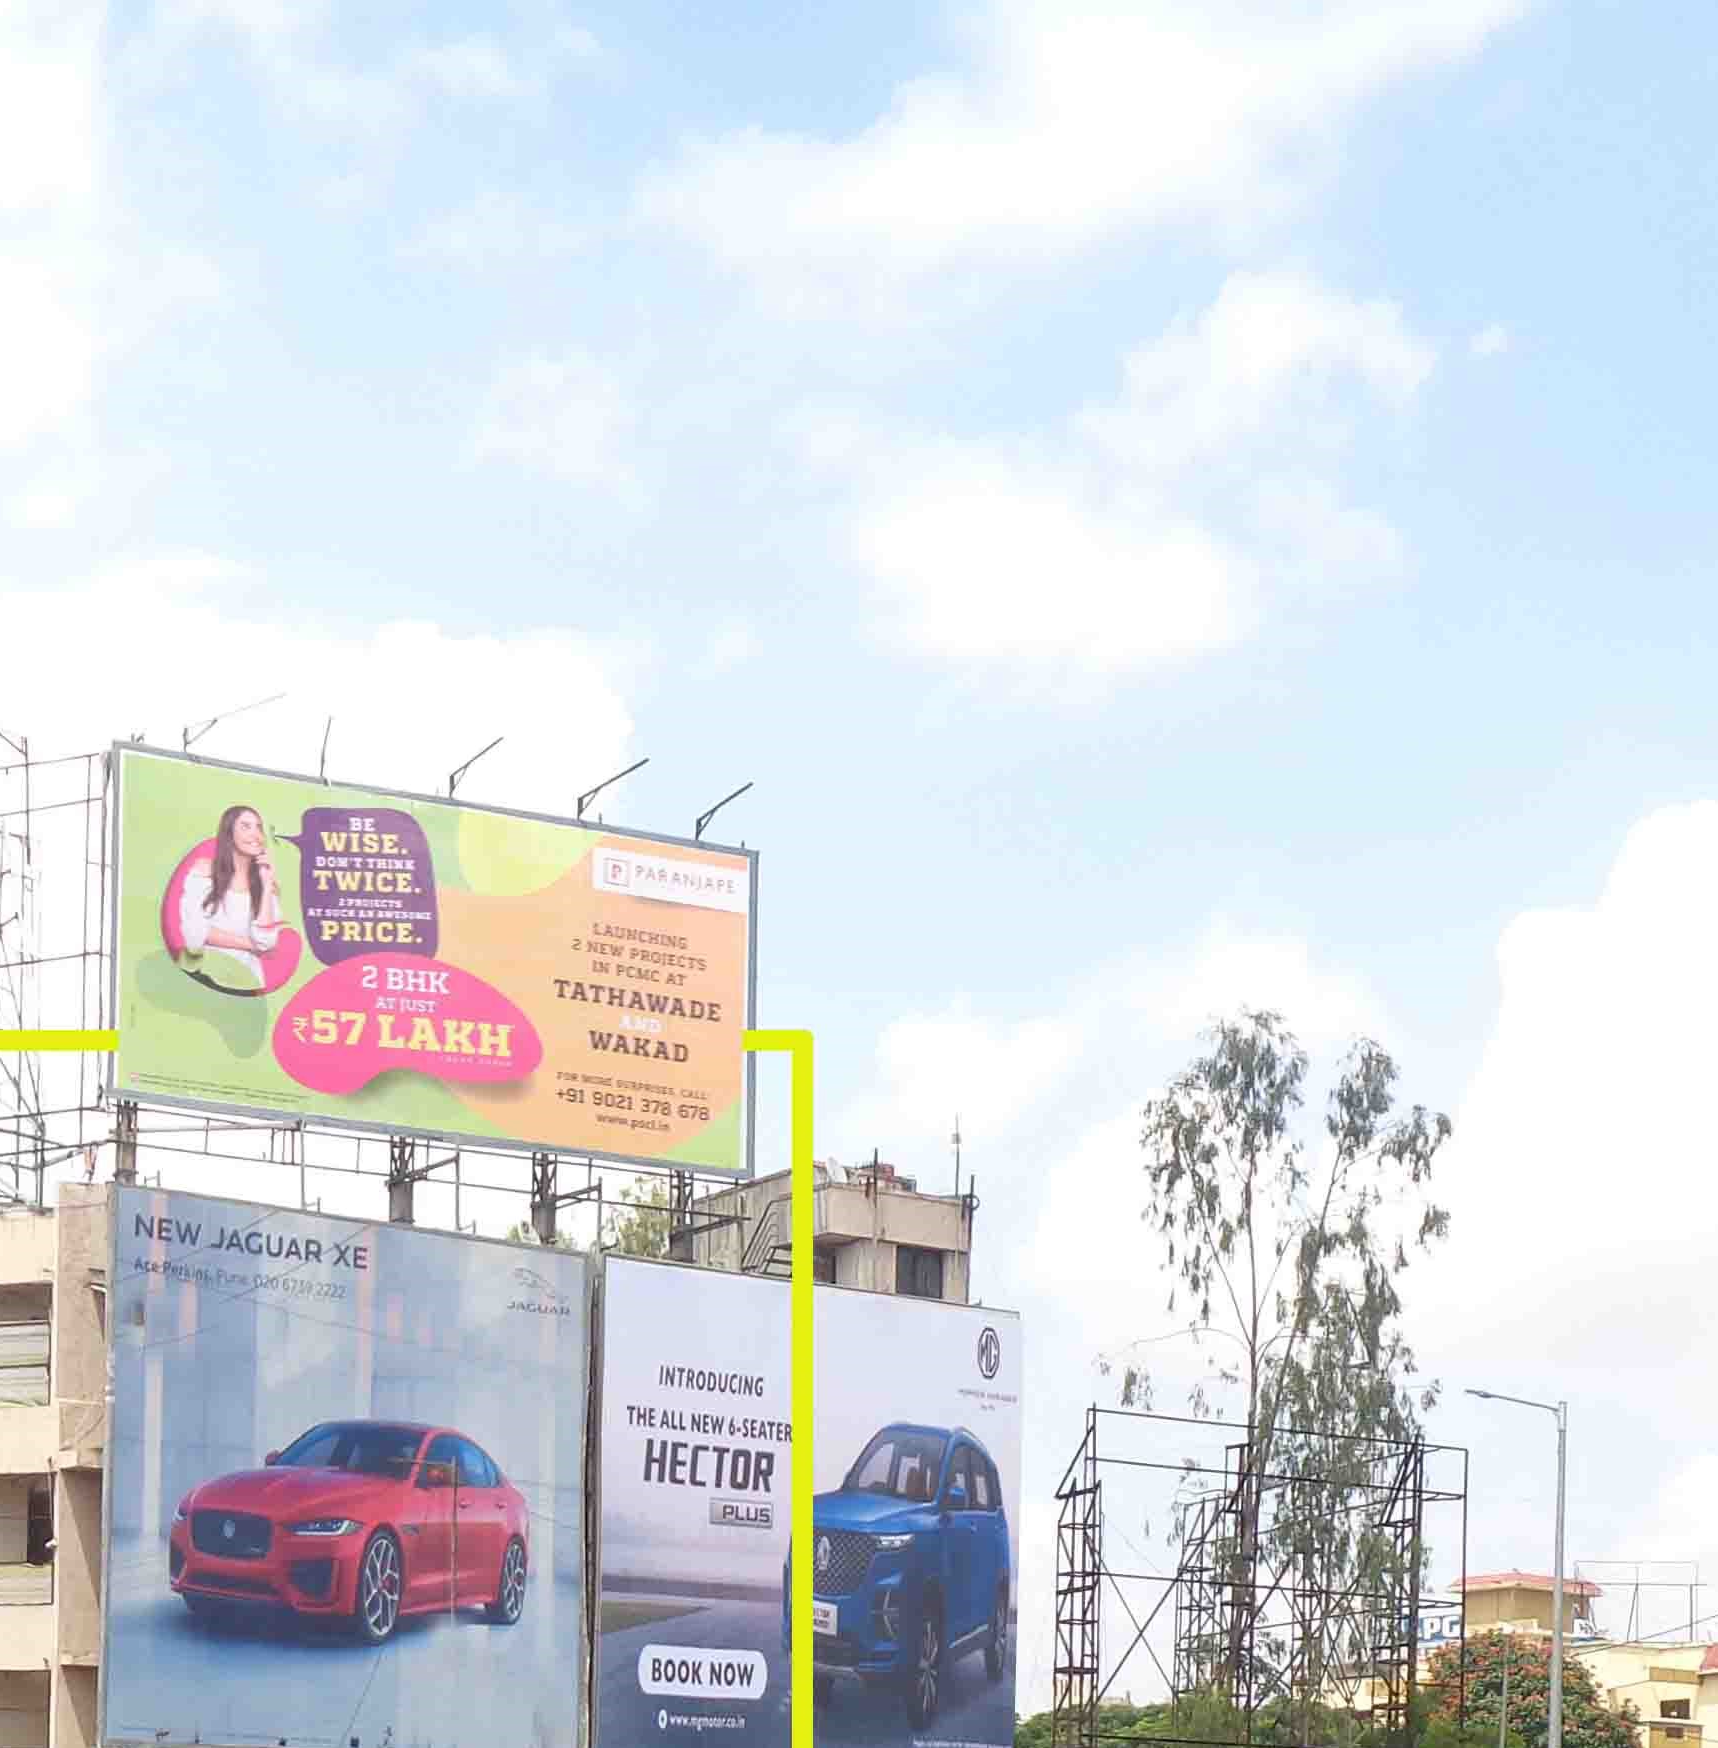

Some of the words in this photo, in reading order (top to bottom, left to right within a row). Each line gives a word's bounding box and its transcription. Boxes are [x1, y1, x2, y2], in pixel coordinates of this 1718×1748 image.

[349, 818, 375, 832] BE
[320, 831, 409, 855] WISE.
[366, 858, 415, 871] THINK
[312, 870, 422, 894] TWICE.
[636, 865, 736, 894] PARANJAPE
[320, 921, 424, 944] PRICE.
[593, 922, 689, 950] LAUNCHING
[571, 938, 582, 951] 2
[587, 940, 624, 957] NEW
[630, 947, 708, 972] PROJECTS
[362, 966, 378, 989] 2
[386, 967, 450, 995] BHK
[593, 960, 610, 974] IN
[616, 963, 661, 984] PCMC
[666, 969, 687, 987] AT
[376, 996, 397, 1011] AT
[553, 978, 722, 1023] TATHAWADE
[377, 1014, 516, 1057] LAKH
[589, 1030, 690, 1064] WAKAD
[555, 1088, 584, 1105] +91
[593, 1091, 633, 1111] 9021
[641, 1097, 673, 1117] 378
[678, 1102, 711, 1122] 678
[134, 1214, 203, 1247] NEW
[206, 1227, 322, 1264] JAGUAR
[334, 1243, 370, 1270] XE
[659, 1365, 764, 1398] INTRODUCING
[627, 1405, 656, 1428] THE
[660, 1410, 687, 1431] ALL
[691, 1413, 725, 1435] NEW
[729, 1418, 793, 1443] 6-SEATER
[643, 1438, 775, 1493] HECTOR
[722, 1504, 771, 1523] PLUS
[651, 1657, 703, 1685] BOOK
[710, 1661, 755, 1687] NOW
